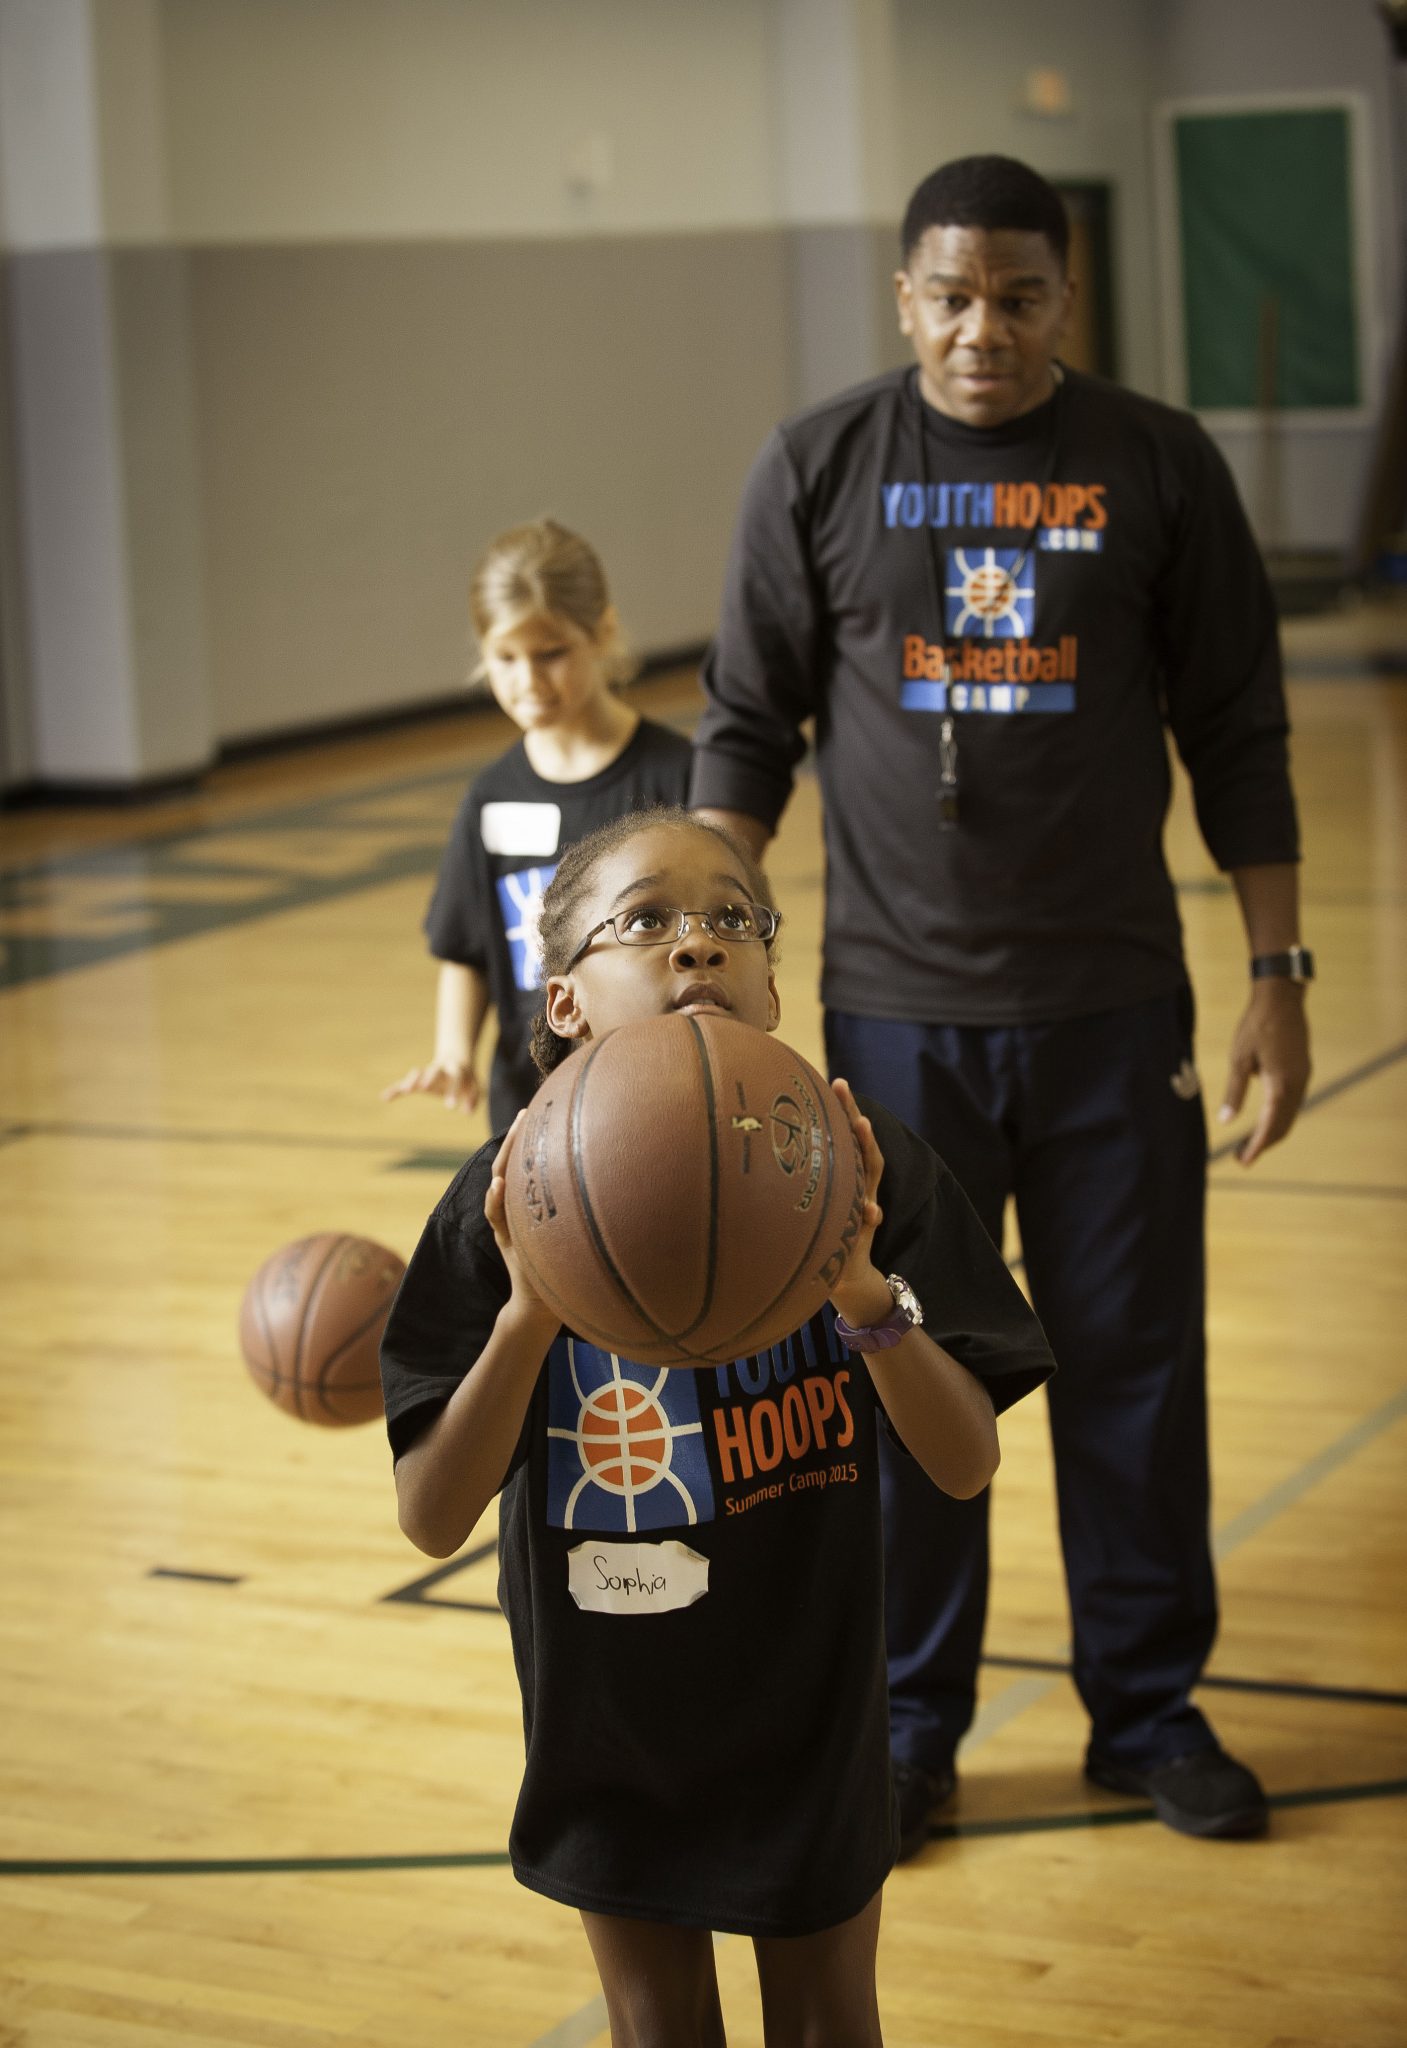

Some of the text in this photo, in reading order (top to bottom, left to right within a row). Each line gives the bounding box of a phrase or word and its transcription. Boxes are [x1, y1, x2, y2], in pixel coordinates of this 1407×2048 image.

[713, 1370, 854, 1483] HOOPS
[725, 1463, 858, 1516] Summer Camp 2015
